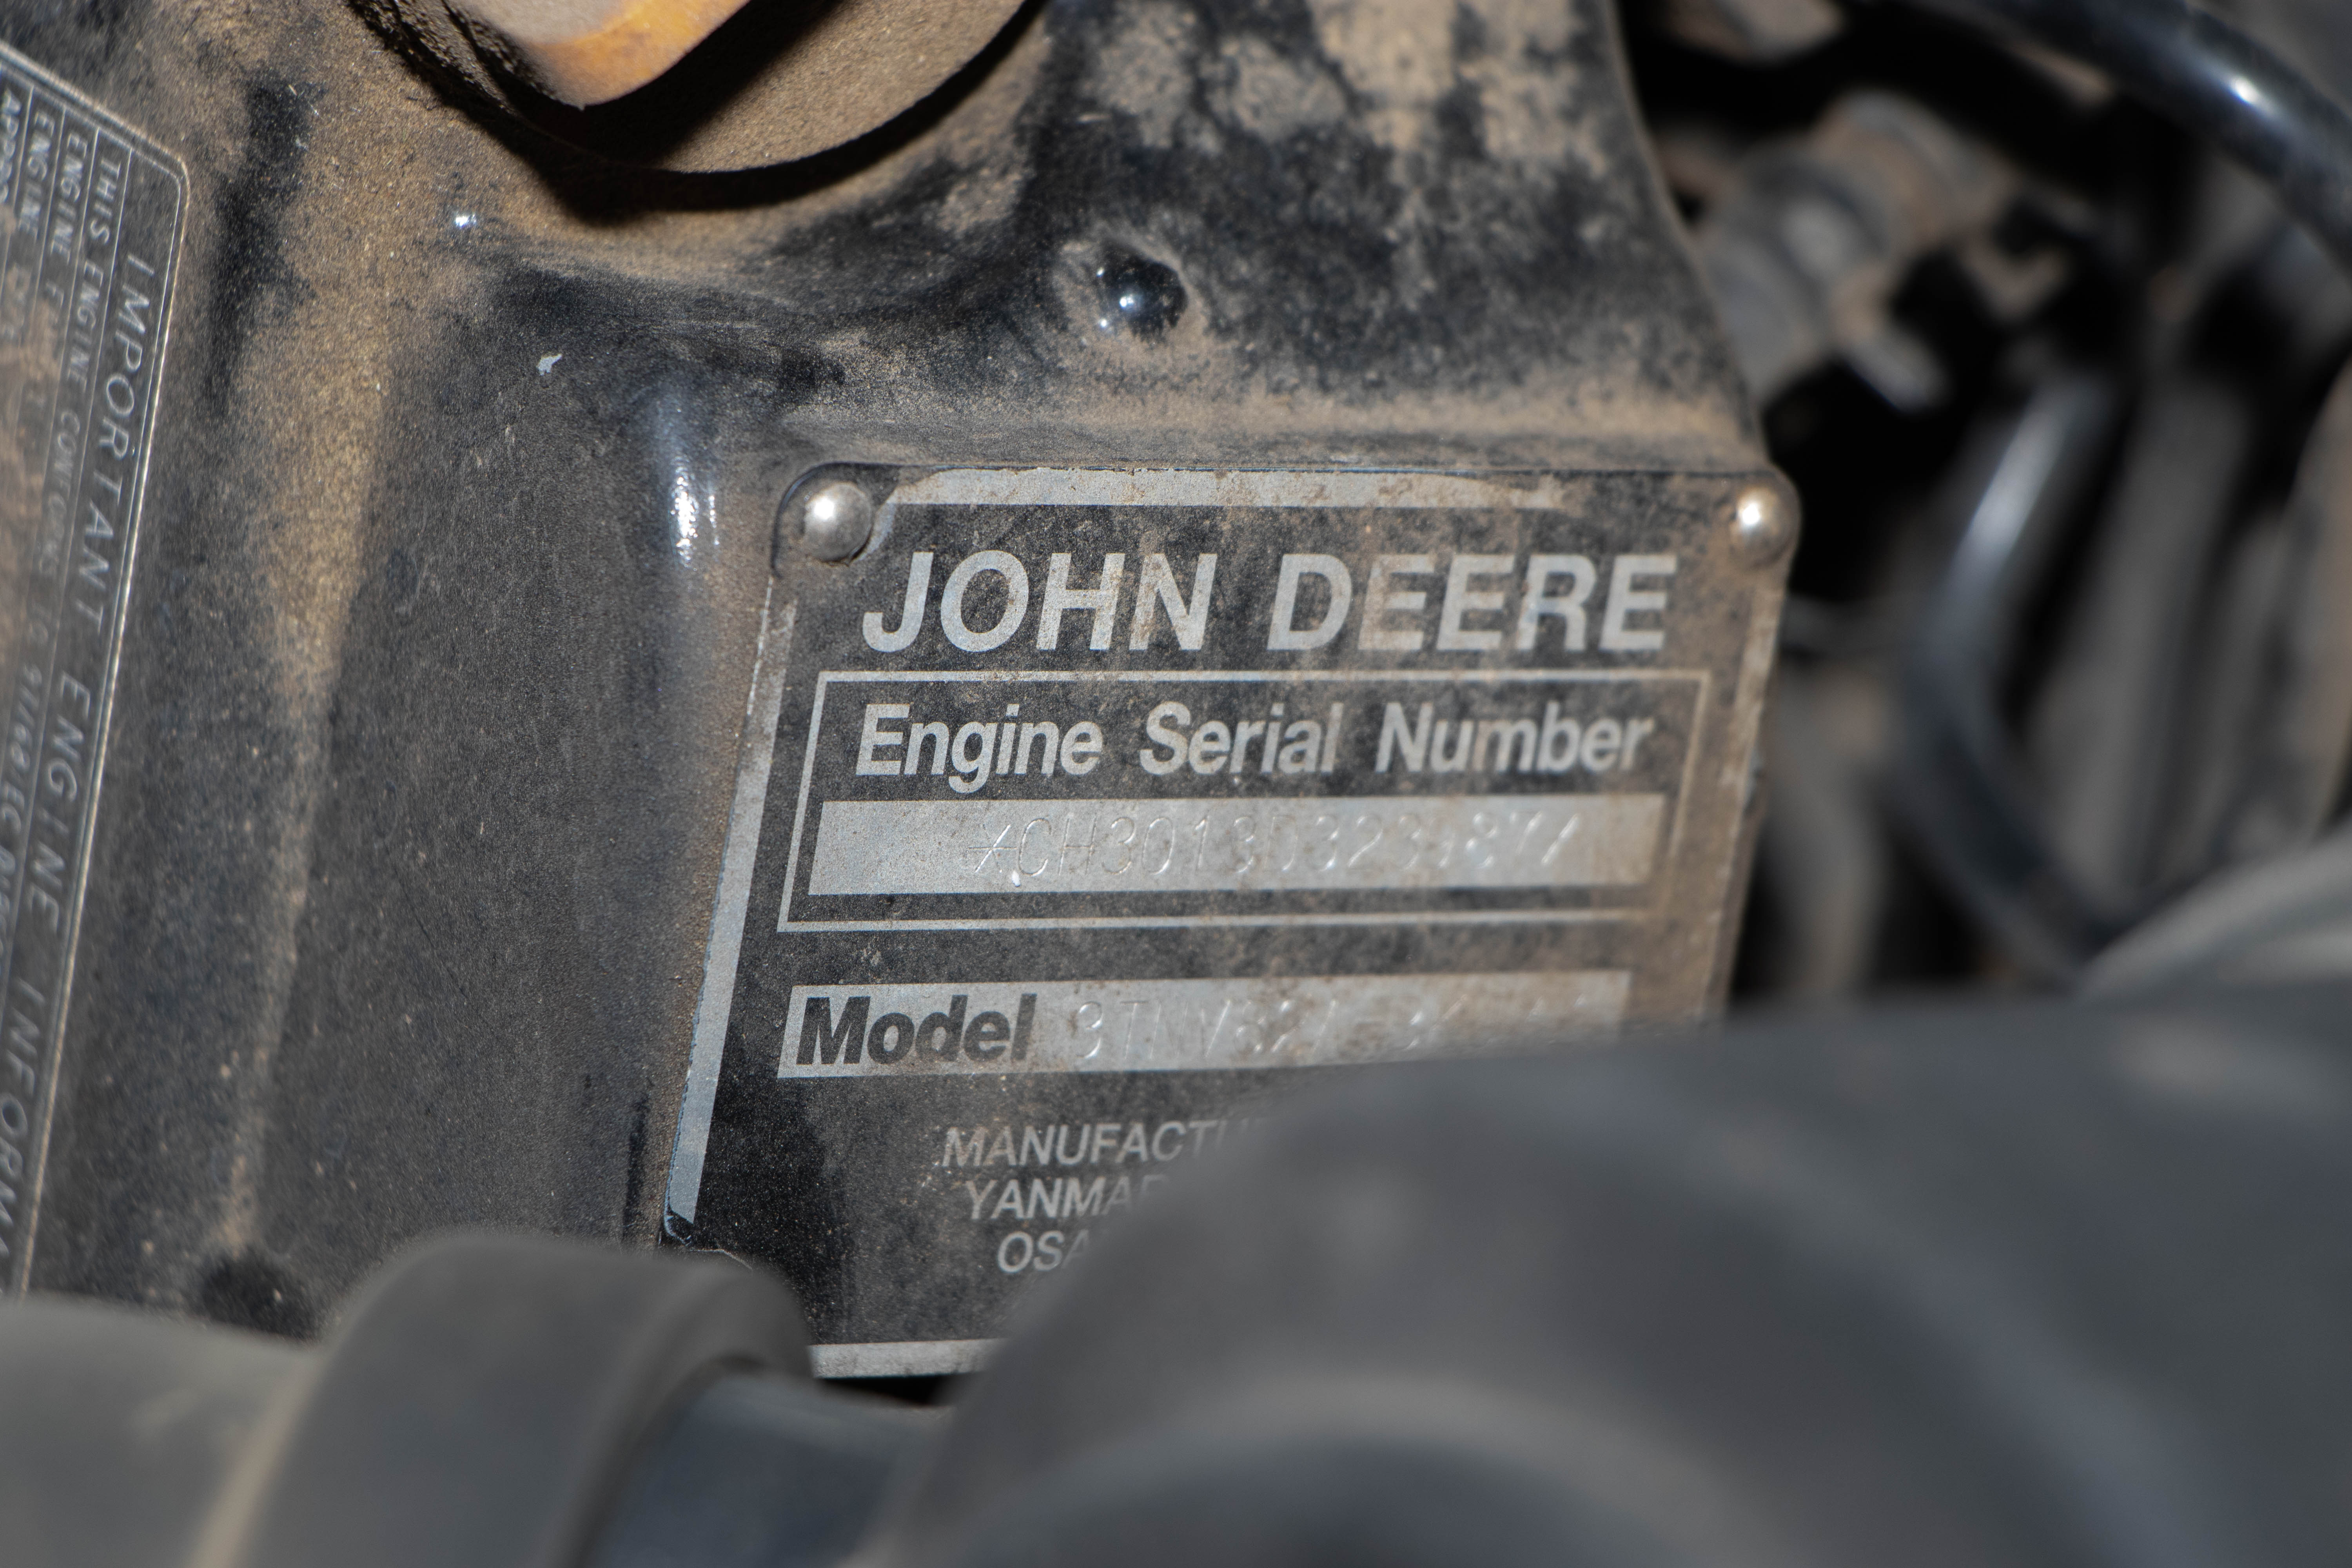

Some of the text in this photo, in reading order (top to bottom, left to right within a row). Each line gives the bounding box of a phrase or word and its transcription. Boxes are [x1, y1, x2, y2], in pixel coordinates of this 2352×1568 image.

[17, 112, 54, 244] ENGINE
[49, 133, 88, 265] ENGINE
[89, 159, 122, 245] THIS
[67, 260, 104, 392] ENGINE
[74, 253, 155, 636] IMPORTANT
[862, 550, 1677, 653] JOHN DEERE
[26, 671, 91, 933] ENGINE
[856, 700, 1654, 793] Engine Serial Number
[796, 993, 1037, 1065] Model
